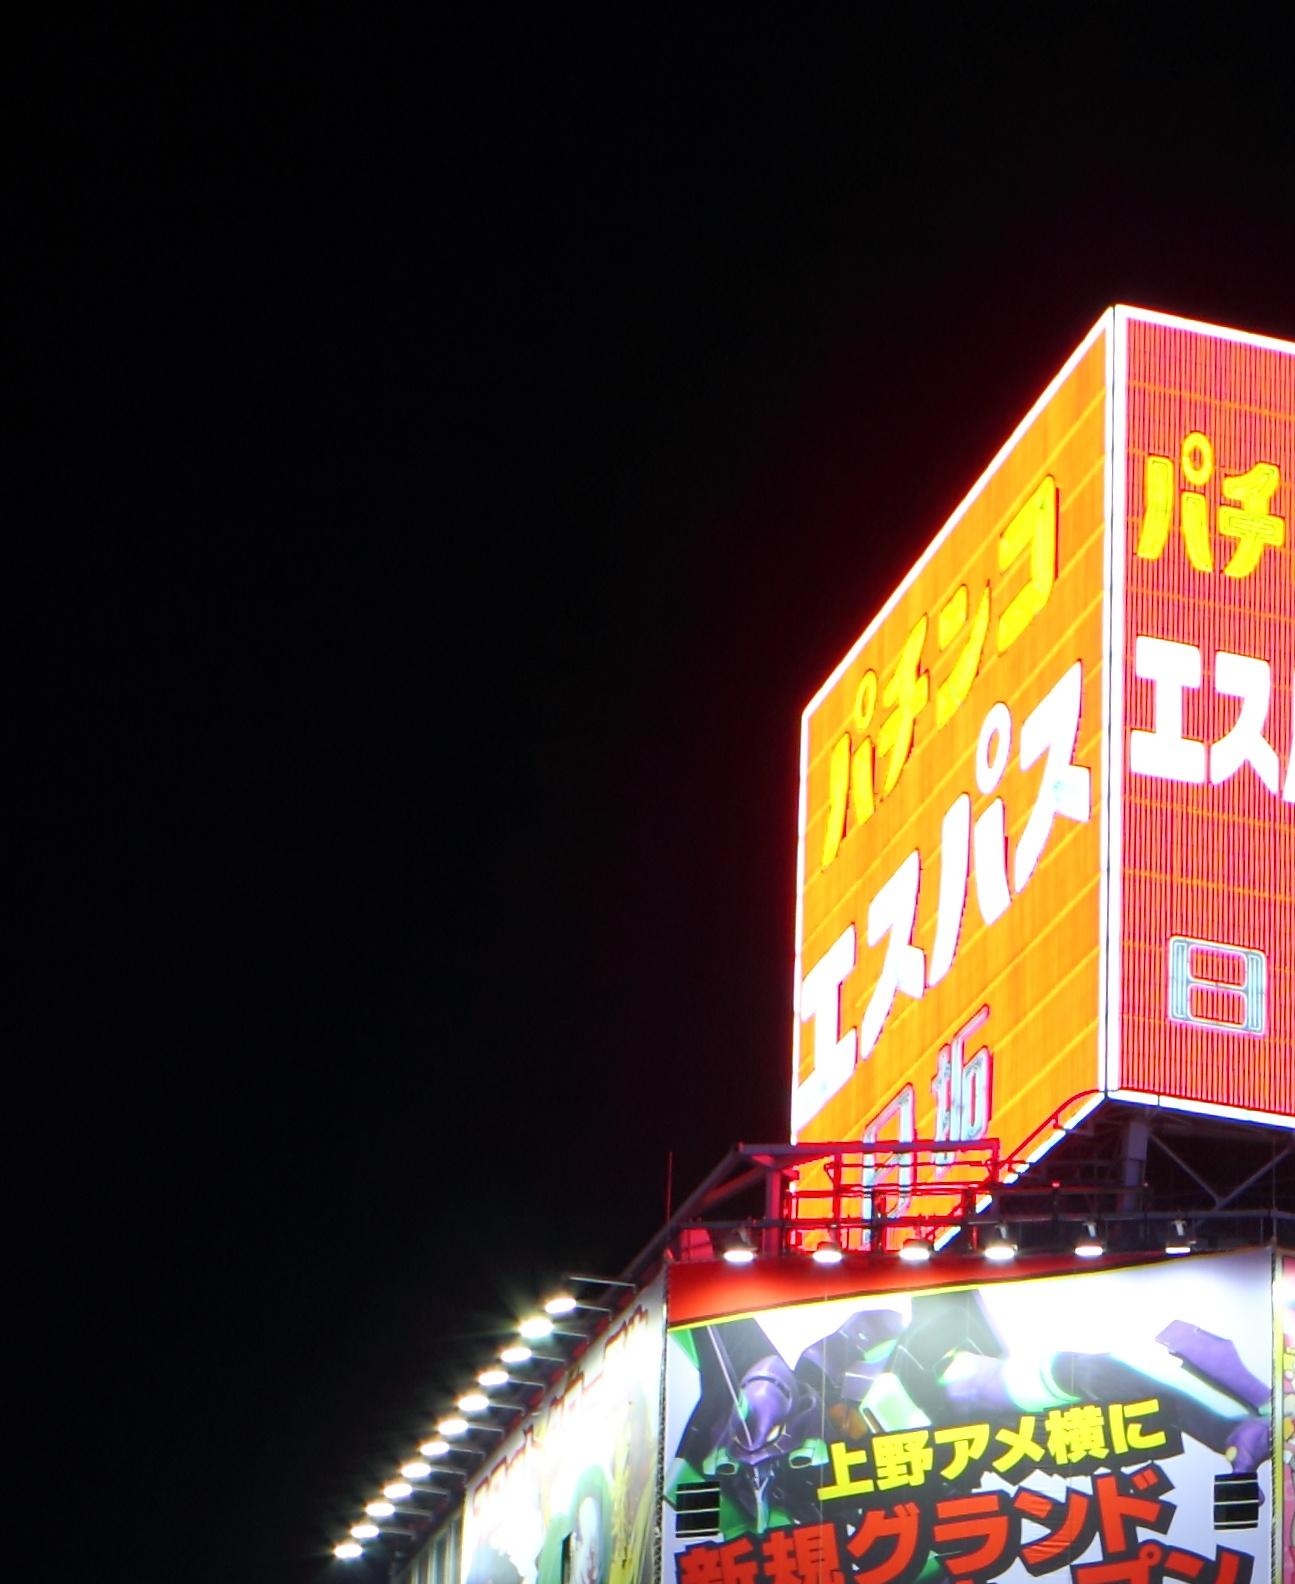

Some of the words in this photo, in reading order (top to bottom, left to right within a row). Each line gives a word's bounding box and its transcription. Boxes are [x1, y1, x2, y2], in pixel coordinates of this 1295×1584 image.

[820, 475, 1058, 868] パチンコ
[794, 659, 1092, 1120] エスパス
[816, 1399, 1166, 1503] 上野アメ横に
